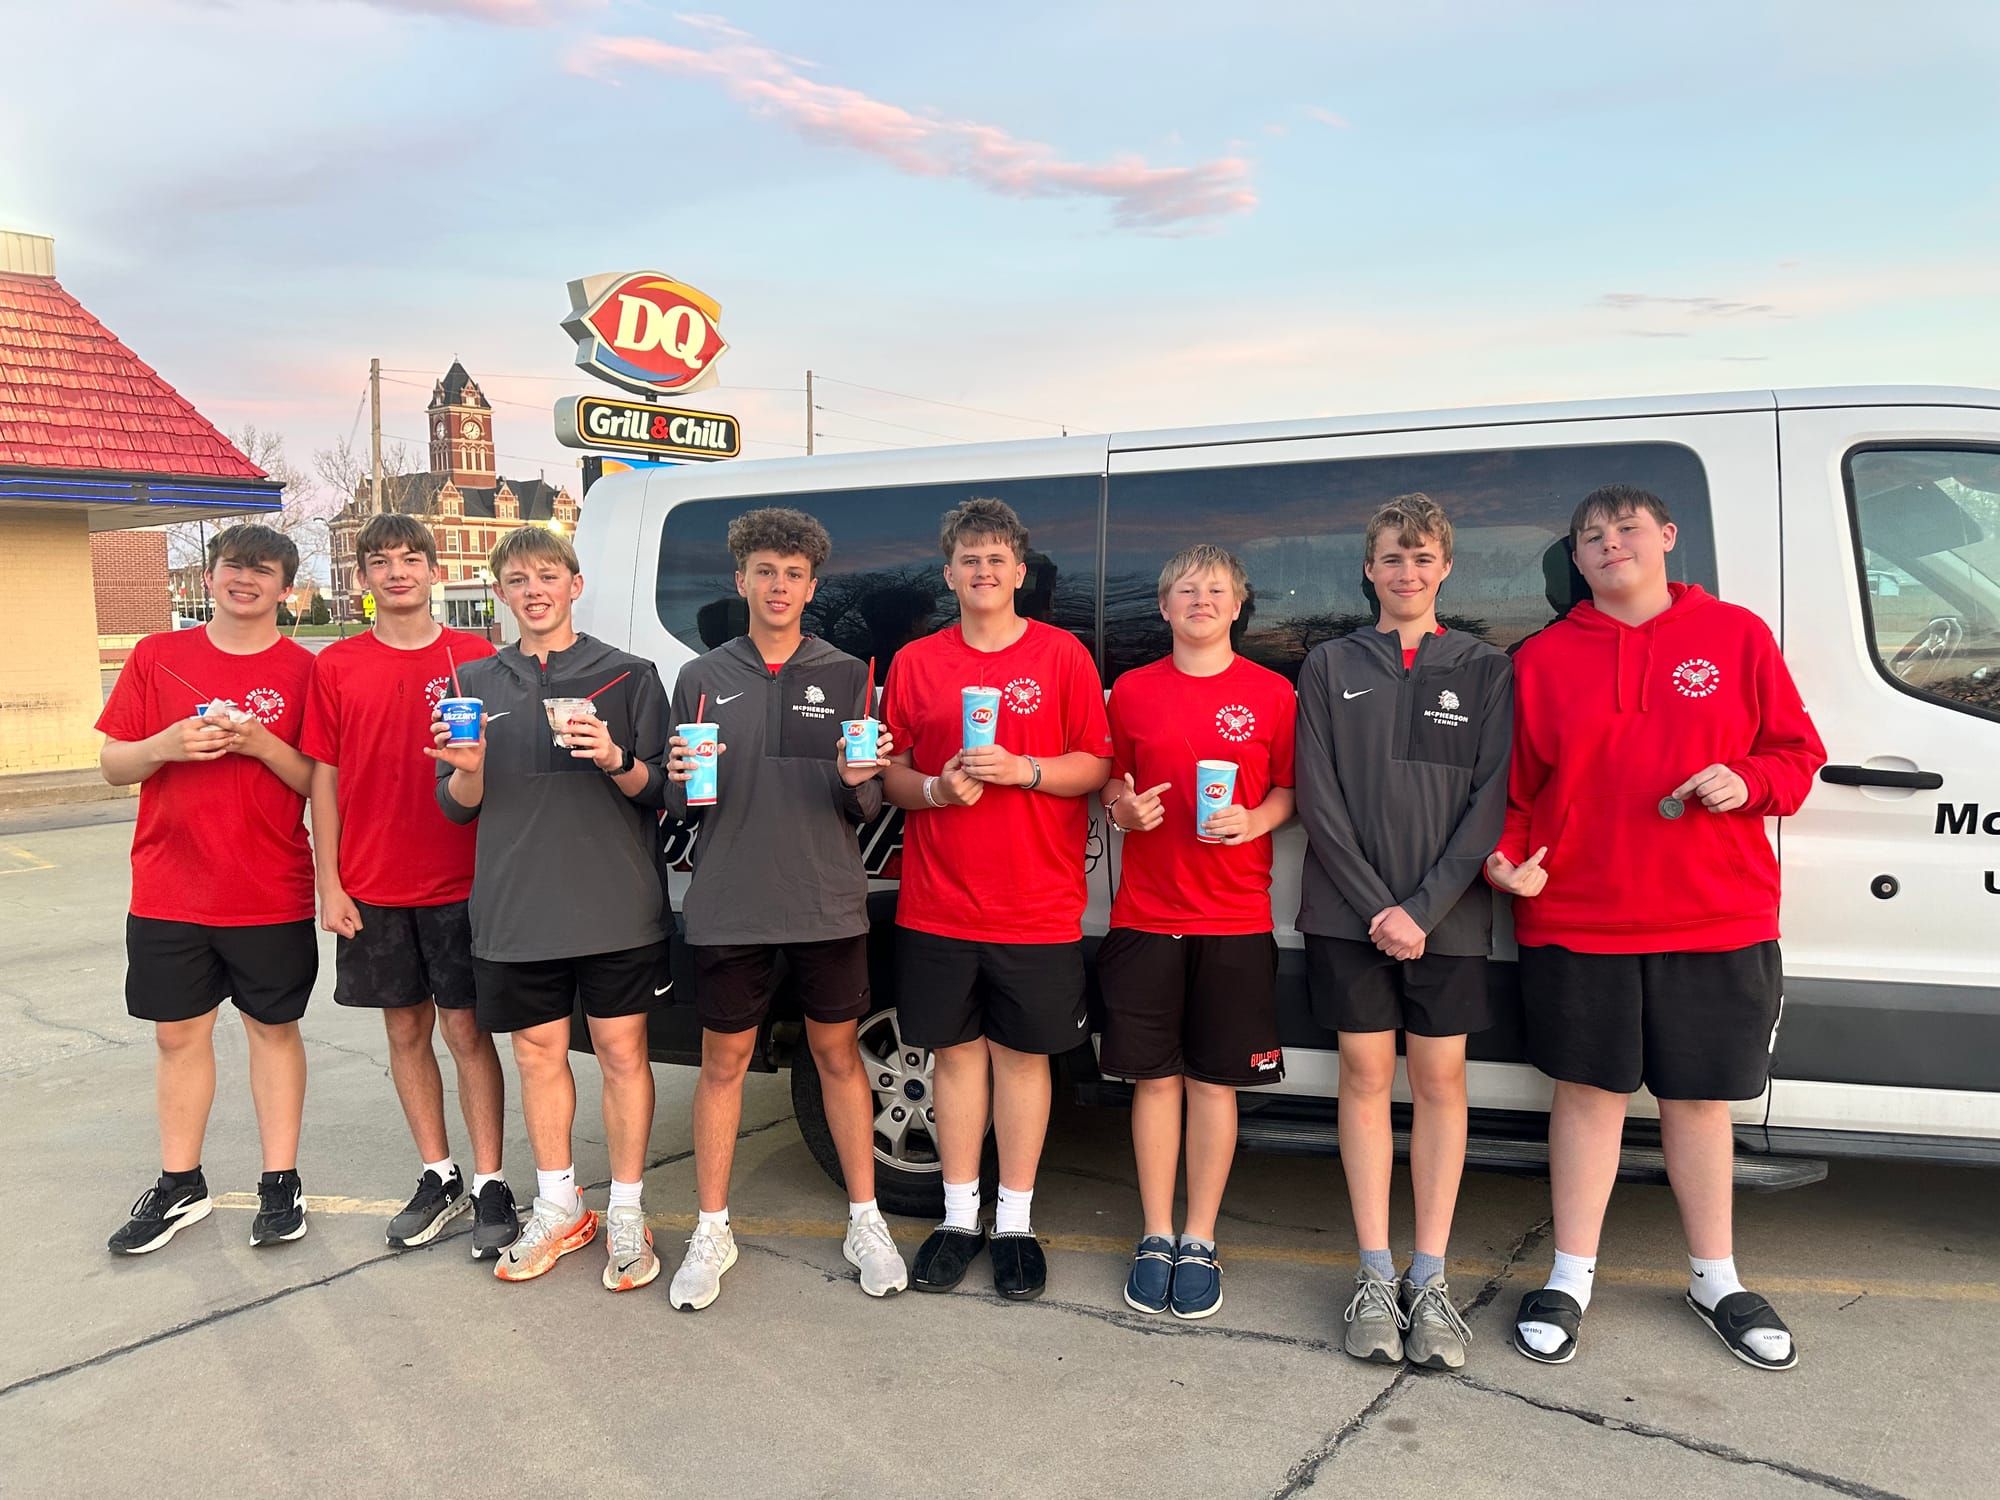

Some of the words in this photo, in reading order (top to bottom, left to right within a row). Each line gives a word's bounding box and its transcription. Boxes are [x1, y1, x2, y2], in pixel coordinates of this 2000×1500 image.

[614, 293, 703, 369] DQ
[1672, 658, 1719, 678] BULLPUPS
[1004, 677, 1042, 696] BULLPUPS
[1677, 684, 1717, 697] TENNIS
[245, 687, 285, 708] BULLPUPS
[801, 711, 825, 719] TENNIS
[1007, 700, 1038, 715] TENNIS
[1215, 704, 1256, 723] BULLPUPS
[975, 711, 991, 721] DQ
[1433, 718, 1459, 727] TENNIS
[1218, 727, 1251, 742] TENNIS
[700, 744, 716, 755] DQ
[1208, 786, 1225, 796] DQ
